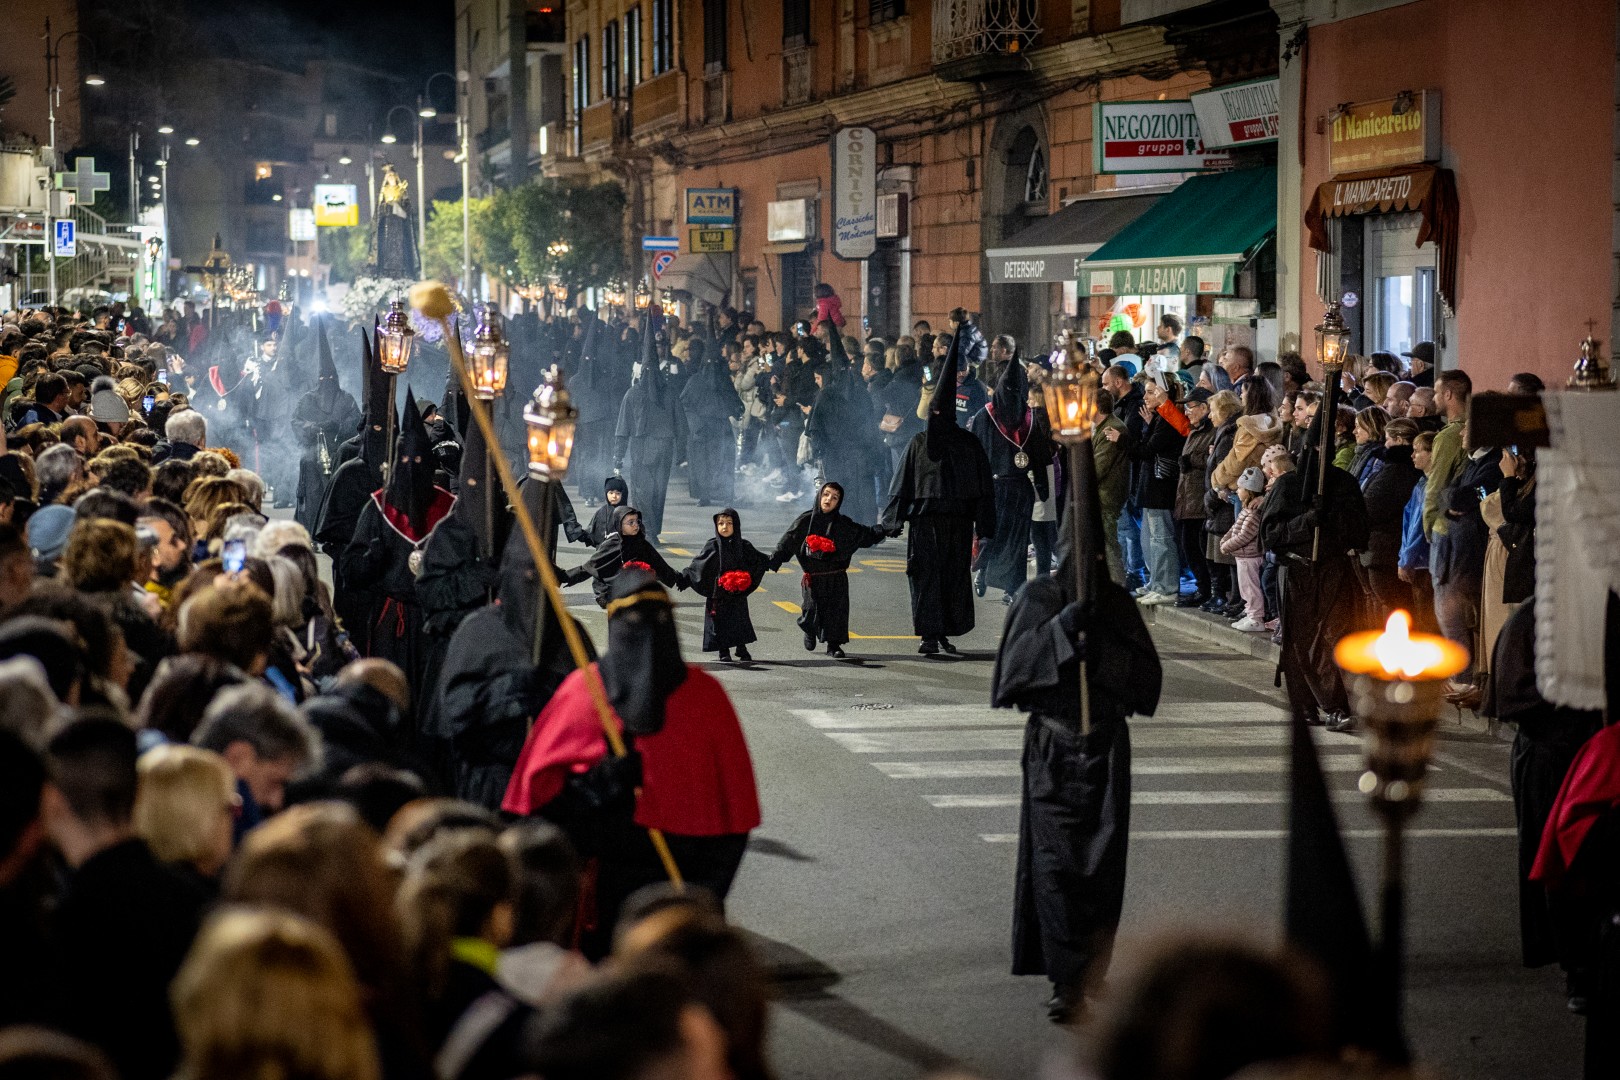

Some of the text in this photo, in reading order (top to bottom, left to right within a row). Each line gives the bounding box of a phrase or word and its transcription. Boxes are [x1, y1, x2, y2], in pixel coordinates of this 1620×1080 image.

[1244, 123, 1263, 137] gruppo
[1333, 109, 1421, 142] Il Manicaretto
[1138, 143, 1182, 155] gruppo
[848, 129, 863, 216] CORNICI
[1334, 176, 1411, 206] IL MANICARETTO
[693, 195, 730, 208] ATM
[836, 212, 873, 229] Classiche
[1004, 260, 1045, 279] DETERSHOP
[1123, 269, 1135, 293] A.
[1138, 267, 1187, 292] ALBANO
